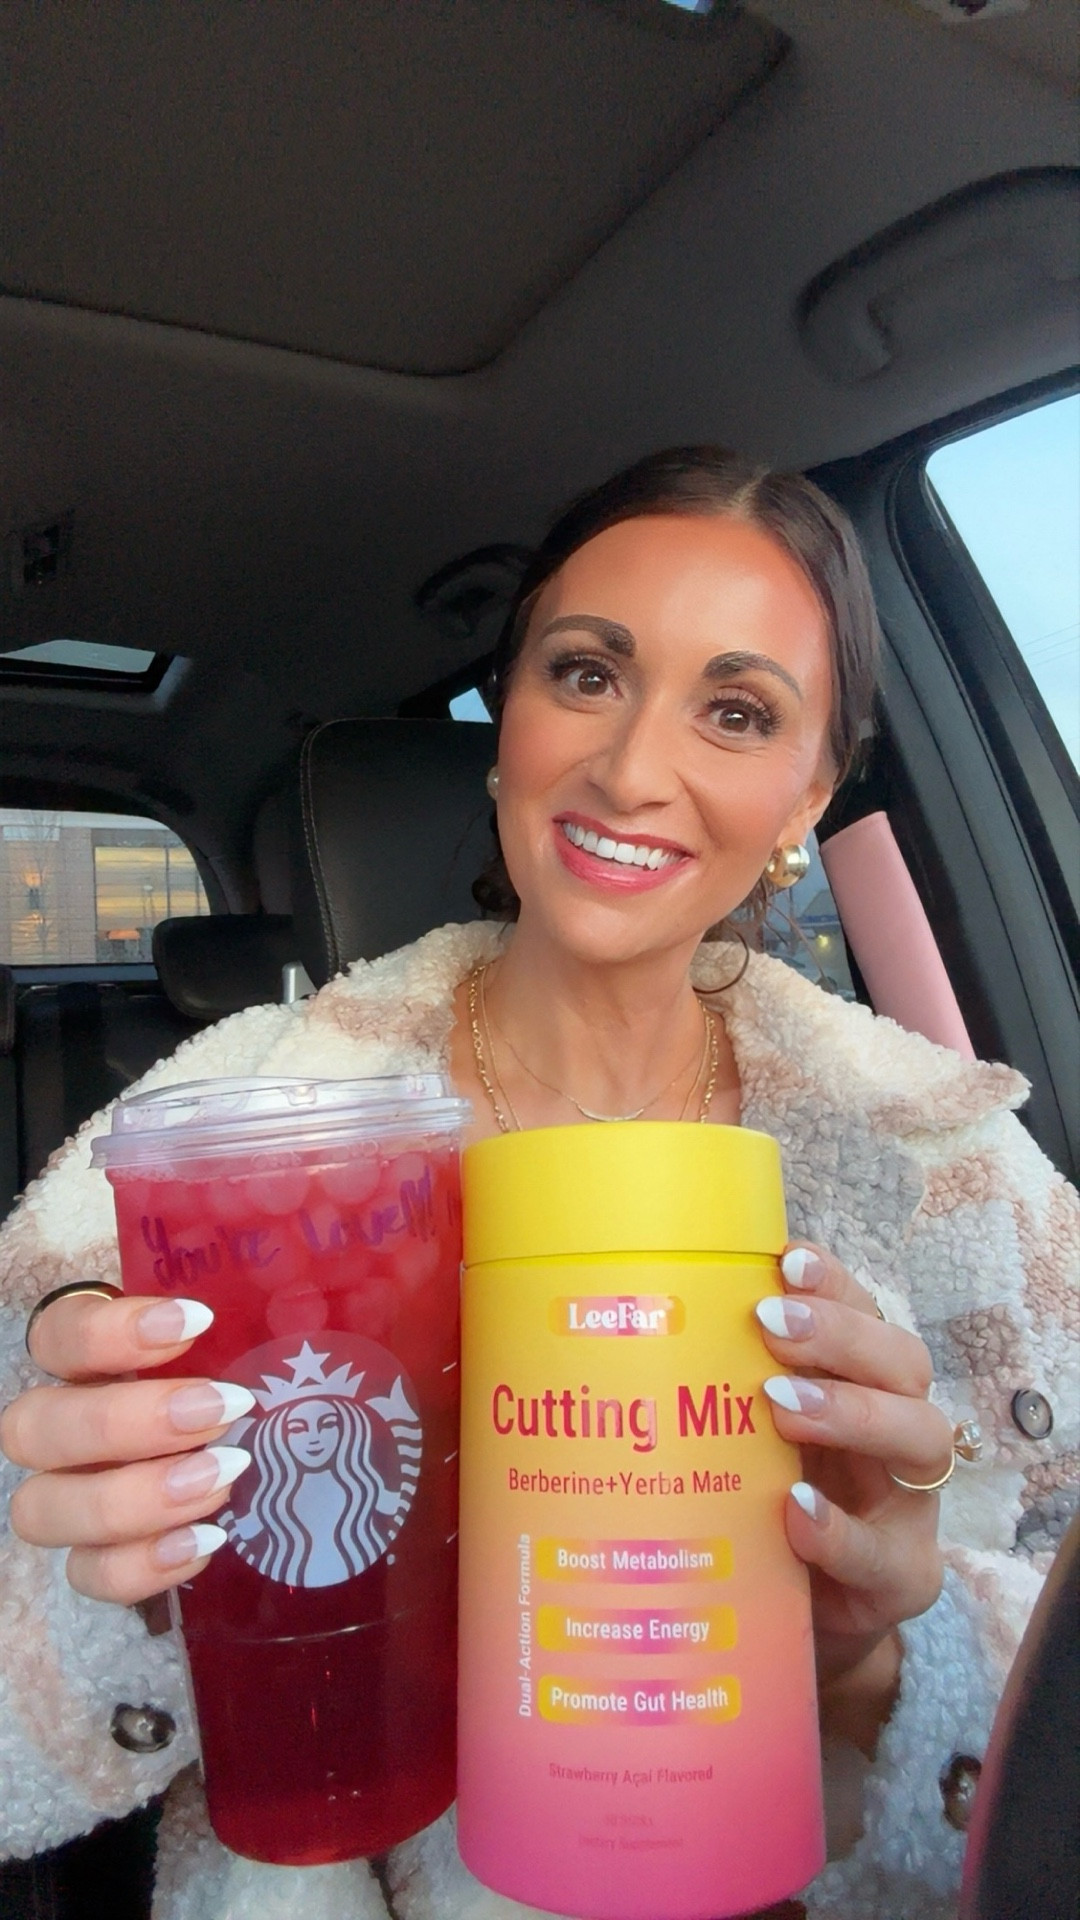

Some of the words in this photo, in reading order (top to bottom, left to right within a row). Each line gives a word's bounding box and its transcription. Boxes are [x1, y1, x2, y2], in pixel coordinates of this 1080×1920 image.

[568, 1302, 667, 1330] LeeFar
[492, 1384, 657, 1453] Cutting
[677, 1383, 756, 1438] Mix
[508, 1467, 685, 1496] Berberine+Yerba
[692, 1470, 742, 1494] Mate
[517, 1533, 531, 1605] Formula
[557, 1548, 607, 1569] Boost
[612, 1549, 714, 1571] Metabolism
[566, 1617, 644, 1640] Increase
[649, 1619, 710, 1642] Energy
[518, 1611, 532, 1717] Dual-Action
[551, 1686, 628, 1712] Promote
[633, 1691, 666, 1712] Gut
[671, 1686, 729, 1711] Health
[549, 1762, 618, 1786] Strawberry
[656, 1764, 714, 1784] Flavored
